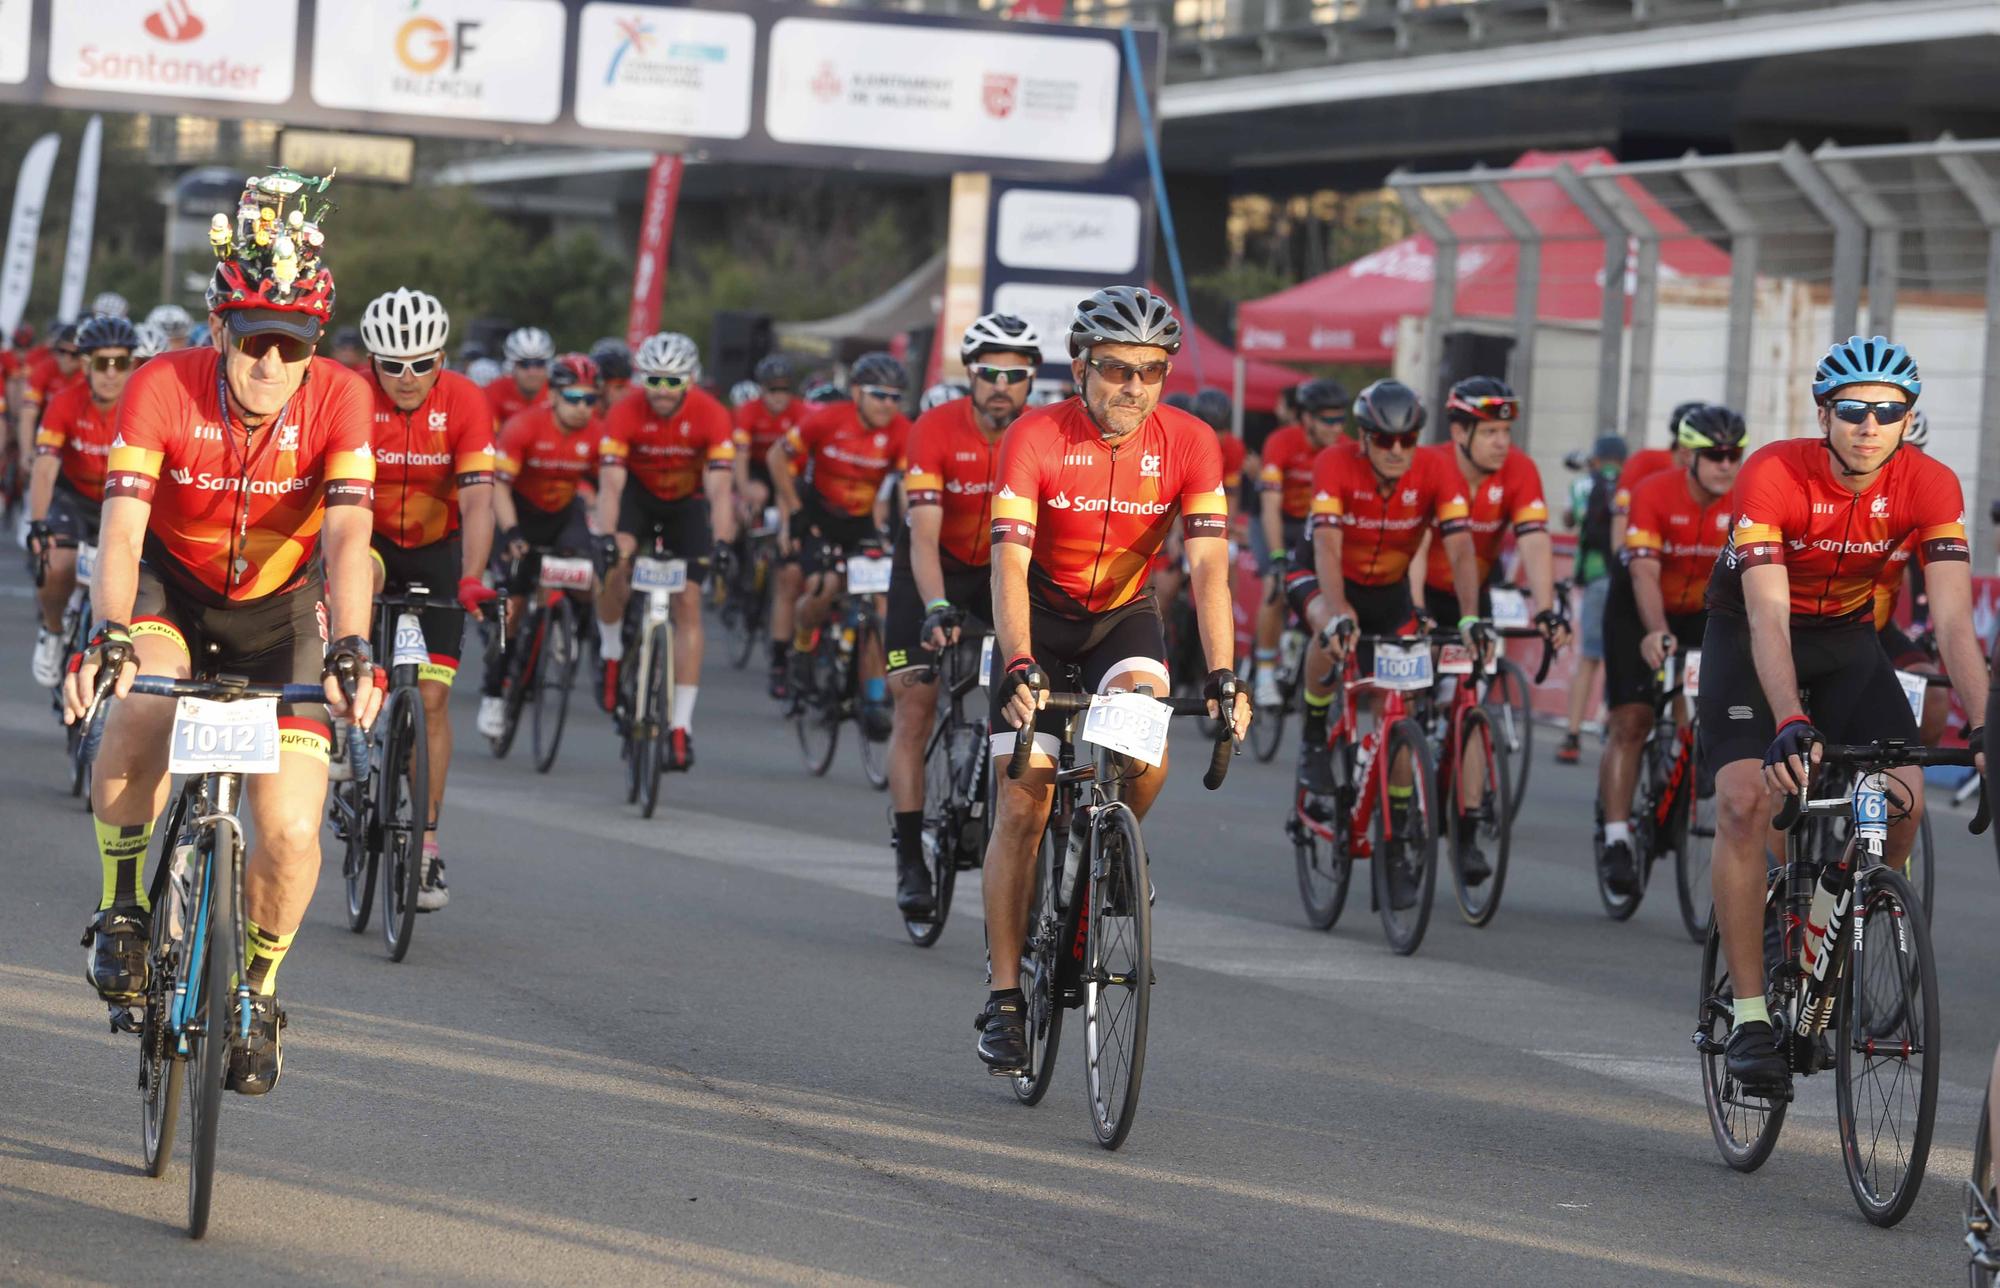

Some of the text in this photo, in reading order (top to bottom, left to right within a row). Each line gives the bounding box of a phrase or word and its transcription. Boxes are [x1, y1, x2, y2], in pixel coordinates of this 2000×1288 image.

[394, 17, 483, 74] GF
[78, 44, 262, 90] Santander
[196, 472, 312, 495] Santander
[1072, 495, 1172, 515] Santander
[1381, 657, 1418, 677] 1007
[182, 722, 257, 753] 1012
[1095, 706, 1152, 740] 1038
[1853, 917, 1864, 951] BMC
[1796, 992, 1820, 1038] BMC
